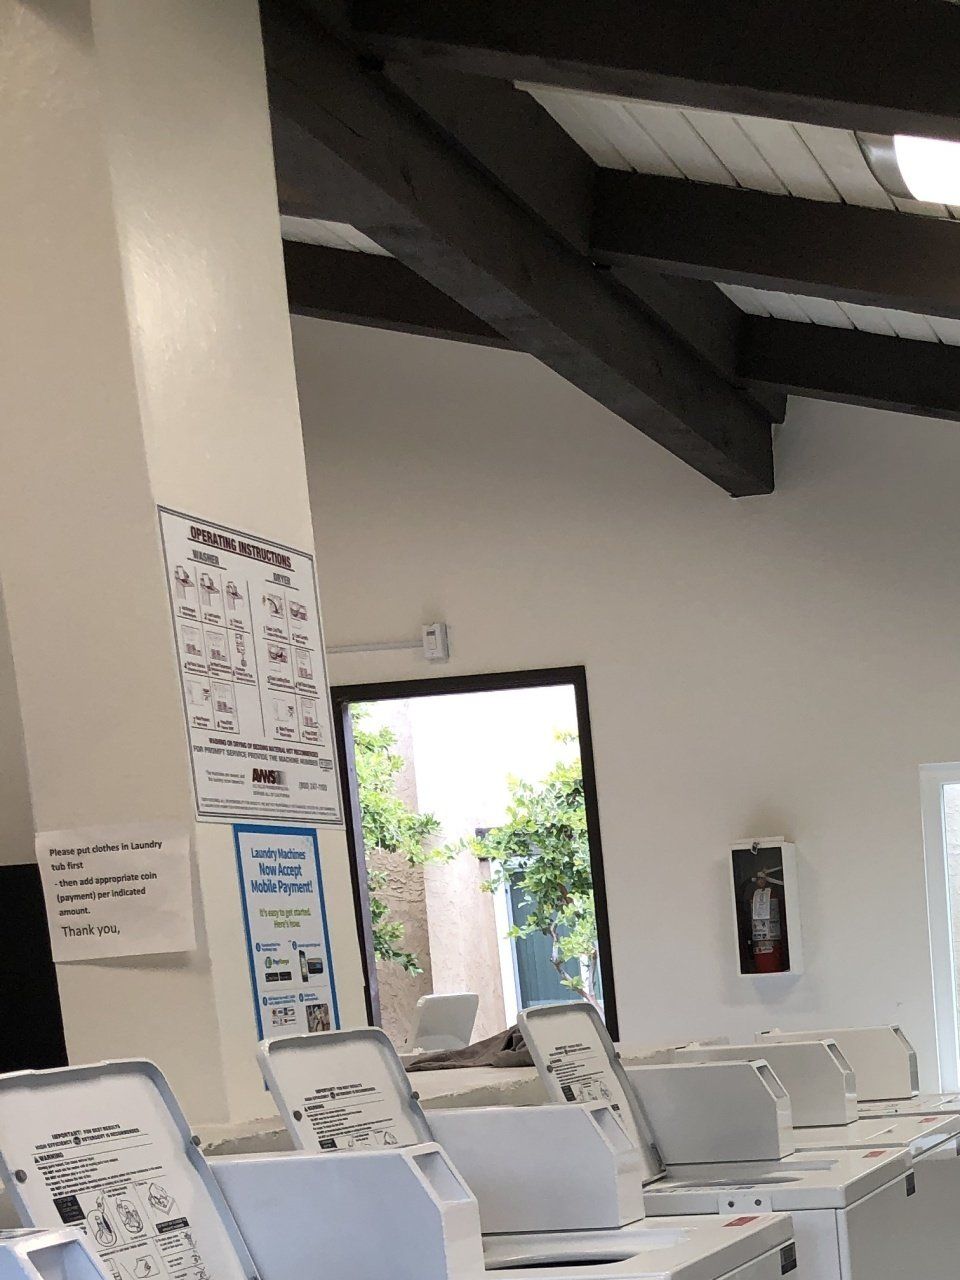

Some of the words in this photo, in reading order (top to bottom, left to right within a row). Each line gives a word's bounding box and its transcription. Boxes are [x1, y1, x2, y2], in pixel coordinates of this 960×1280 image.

[190, 525, 237, 552] OPERATING
[238, 540, 292, 568] INSTRUCTIONS
[49, 848, 75, 857] Please
[77, 847, 90, 857] put
[92, 843, 120, 853] clothes
[122, 842, 129, 850] in
[131, 840, 162, 850] Laundry
[251, 847, 277, 861] Laundry
[278, 848, 306, 860] Machines
[51, 862, 66, 872] tub
[67, 861, 84, 870] first
[259, 862, 276, 876] Now
[278, 862, 302, 879] Accept
[59, 879, 78, 888] then
[80, 877, 94, 886] add
[95, 874, 139, 886] appropriate
[140, 872, 158, 880] coin
[251, 880, 277, 893] Mobile
[278, 880, 313, 896] Payment!
[56, 891, 96, 904] (payment)
[98, 890, 110, 900] per
[112, 887, 146, 898] indicated
[59, 907, 91, 916] amount.
[62, 924, 95, 938] Thank
[96, 924, 120, 938] you,
